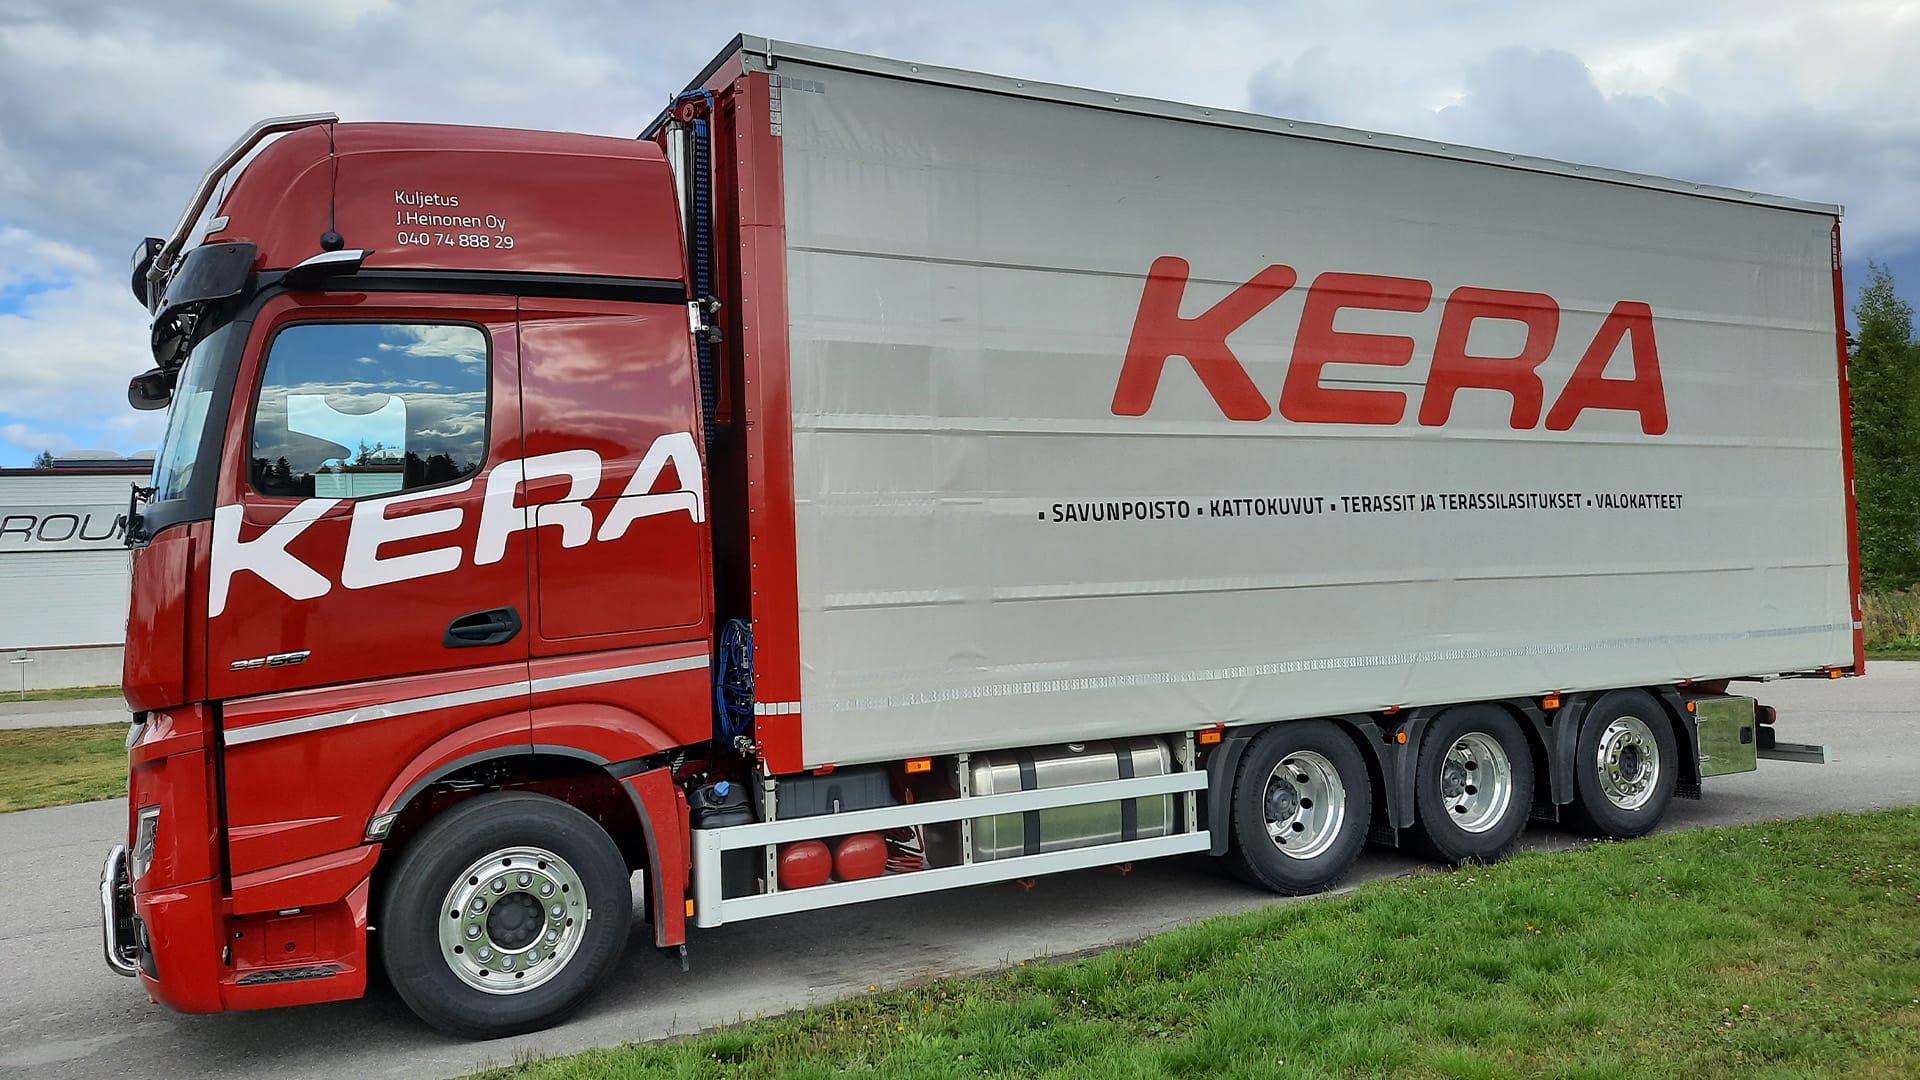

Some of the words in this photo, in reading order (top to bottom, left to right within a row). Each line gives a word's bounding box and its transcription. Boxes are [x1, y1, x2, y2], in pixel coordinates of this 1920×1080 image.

[395, 191, 459, 208] Kuljetus
[396, 211, 481, 228] J.Heinonen
[485, 215, 506, 232] Oy
[398, 232, 430, 246] 040
[434, 233, 455, 247] 74
[458, 234, 490, 248] 888
[494, 236, 514, 249] 29
[1111, 255, 1668, 435] KERA
[1052, 500, 1190, 523] SAVUNPOISTO
[1210, 497, 1324, 518] KATTOKUVUT
[1341, 494, 1416, 514] TERASSIT
[1420, 494, 1436, 512] JA
[1439, 493, 1582, 511] TERASSILASITUKSET
[1595, 493, 1683, 510] VALOKATTEET
[208, 432, 705, 618] KERA
